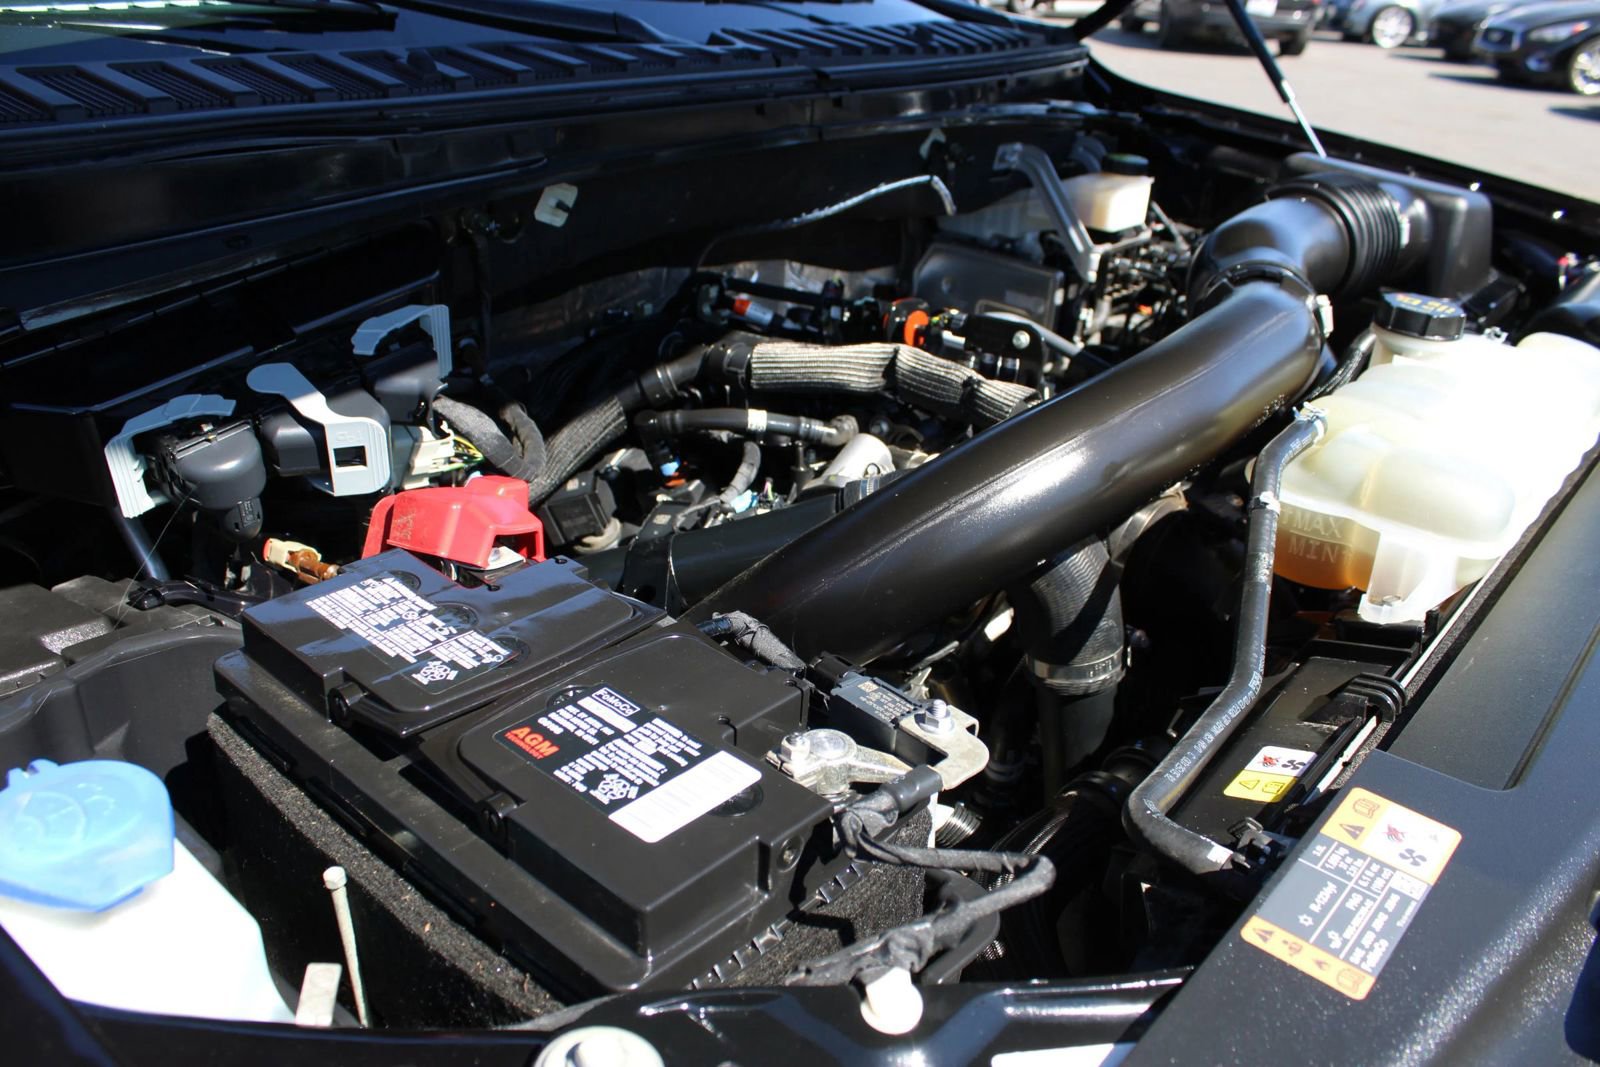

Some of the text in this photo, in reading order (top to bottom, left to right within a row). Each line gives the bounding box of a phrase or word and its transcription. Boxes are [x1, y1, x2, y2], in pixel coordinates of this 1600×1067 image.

[1293, 510, 1342, 537] MAX
[1288, 536, 1338, 563] MIN
[595, 690, 635, 714] FoMoCo
[510, 726, 560, 756] AGM
